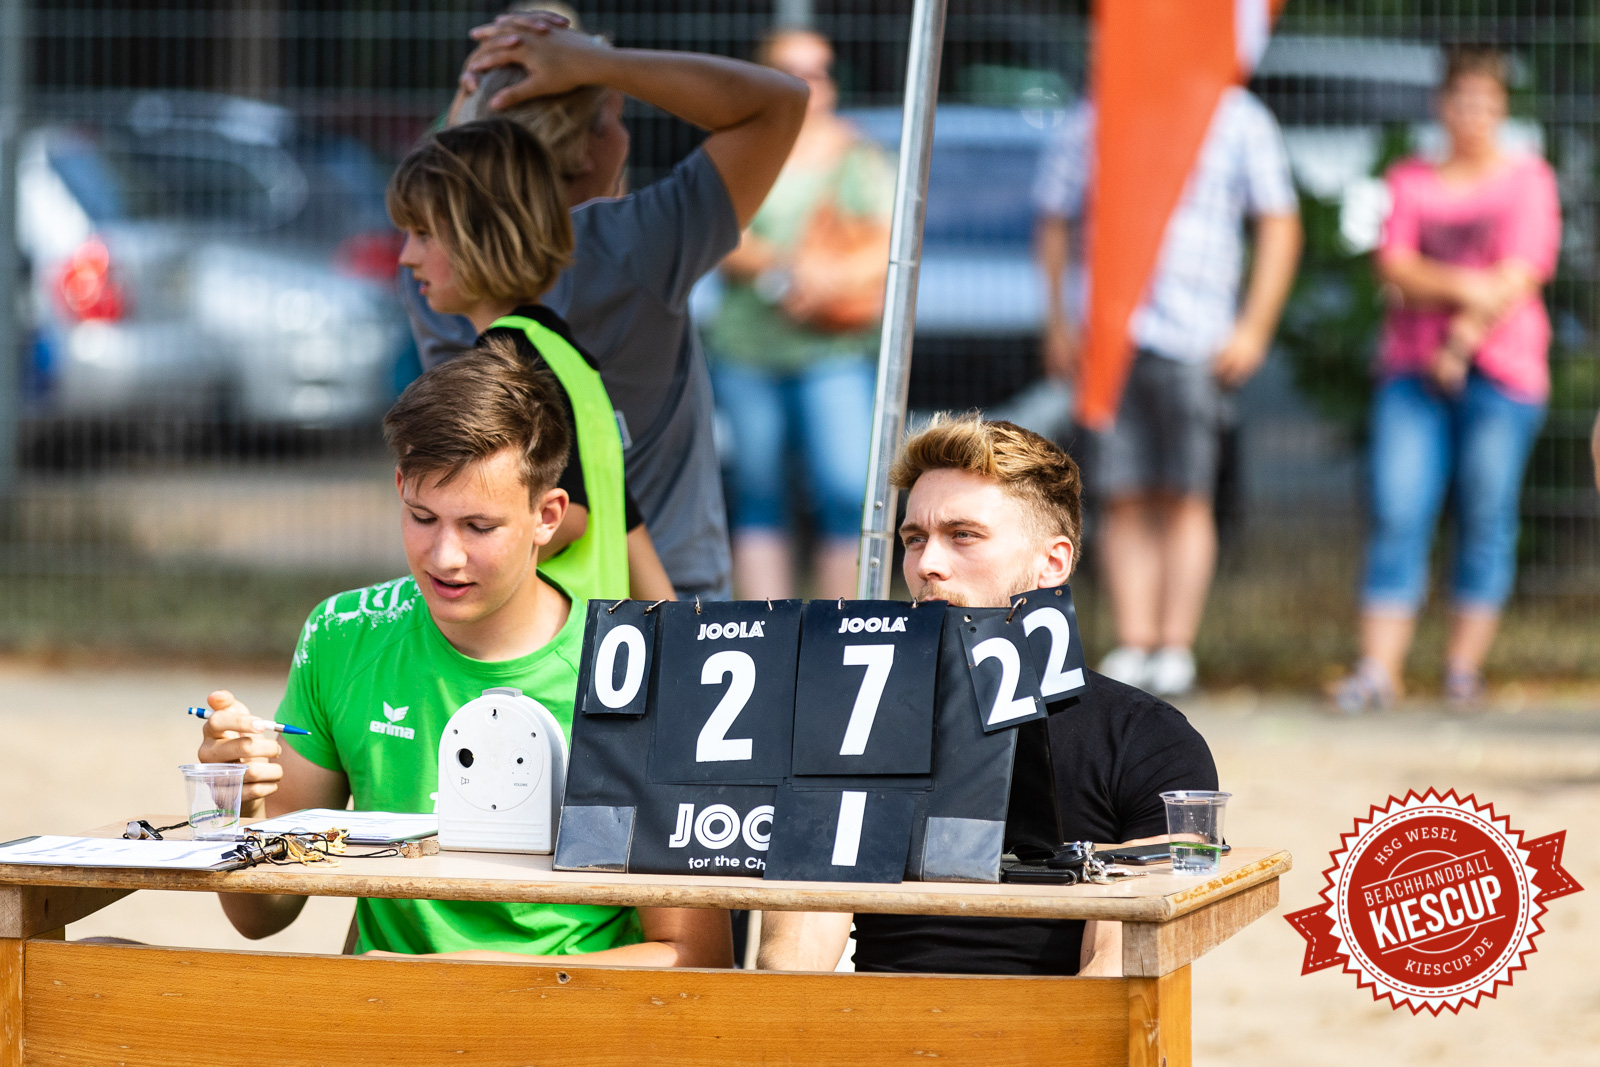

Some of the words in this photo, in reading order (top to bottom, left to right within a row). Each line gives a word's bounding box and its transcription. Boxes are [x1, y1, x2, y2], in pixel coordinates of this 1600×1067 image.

[697, 621, 766, 640] JOOLA
[838, 616, 908, 633] JOOLA
[1022, 607, 1086, 698] 2
[594, 624, 647, 709] 0
[971, 637, 1037, 726] 2
[369, 720, 415, 740] erima
[696, 650, 756, 762] 2
[839, 644, 895, 756] 7
[668, 803, 775, 851] JOO
[688, 857, 710, 869] for
[714, 855, 740, 867] the
[745, 857, 766, 871] Ch
